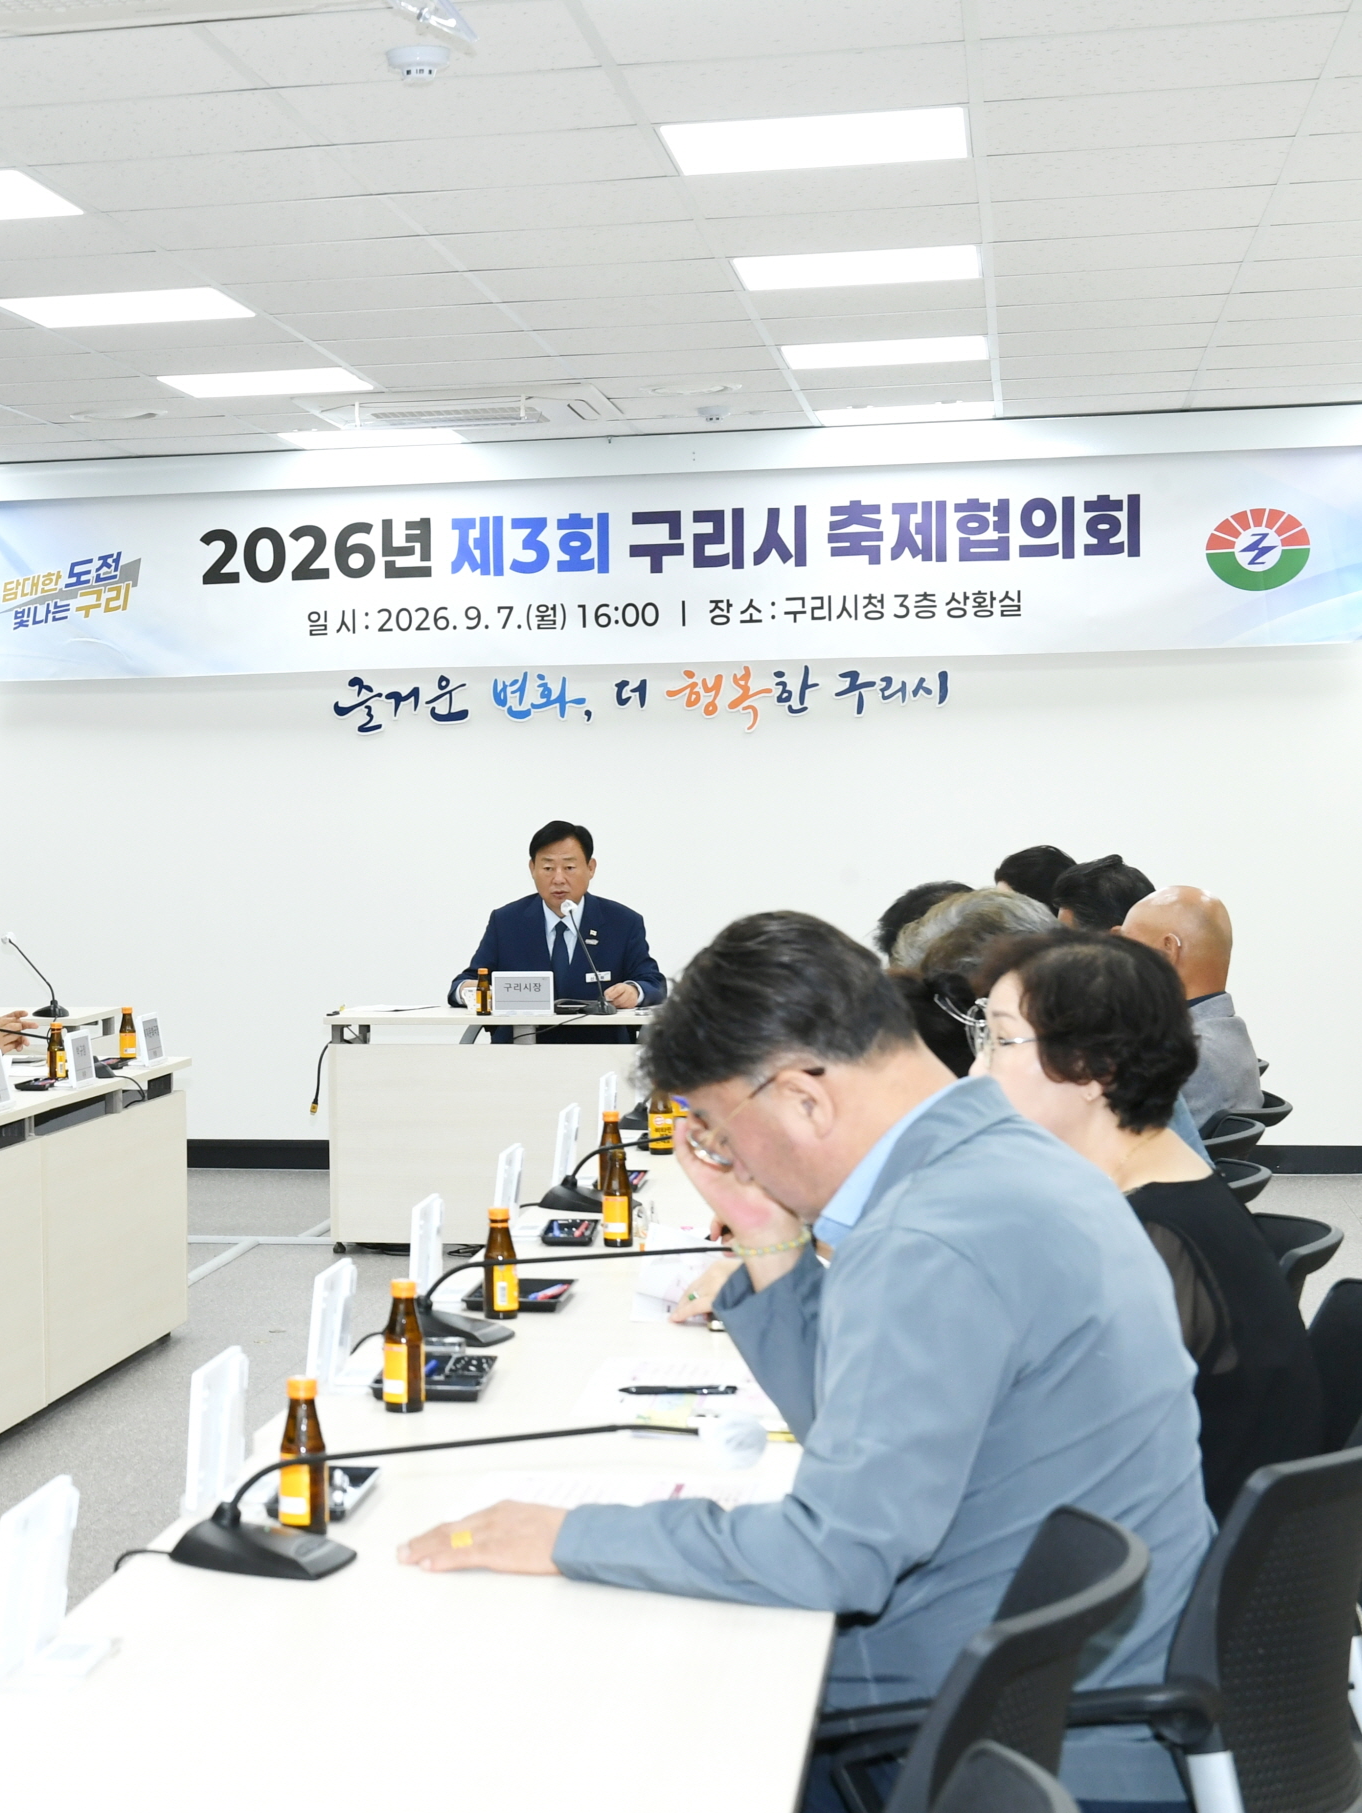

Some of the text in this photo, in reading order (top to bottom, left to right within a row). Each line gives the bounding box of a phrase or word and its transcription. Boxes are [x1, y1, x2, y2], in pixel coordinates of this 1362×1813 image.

[200, 494, 1140, 585] 2026년 제3회 구리시 축제협의회
[1, 551, 123, 603] 담대한 도전
[13, 582, 131, 630] 빛나는 구리
[578, 602, 659, 628] 16:00
[784, 594, 884, 623] 구리시청
[894, 592, 937, 619] 3층
[946, 590, 1021, 618] 상황실
[334, 665, 948, 732] 즐거운 변화, 더 행복한 구리시
[504, 982, 542, 993] 구리시장
